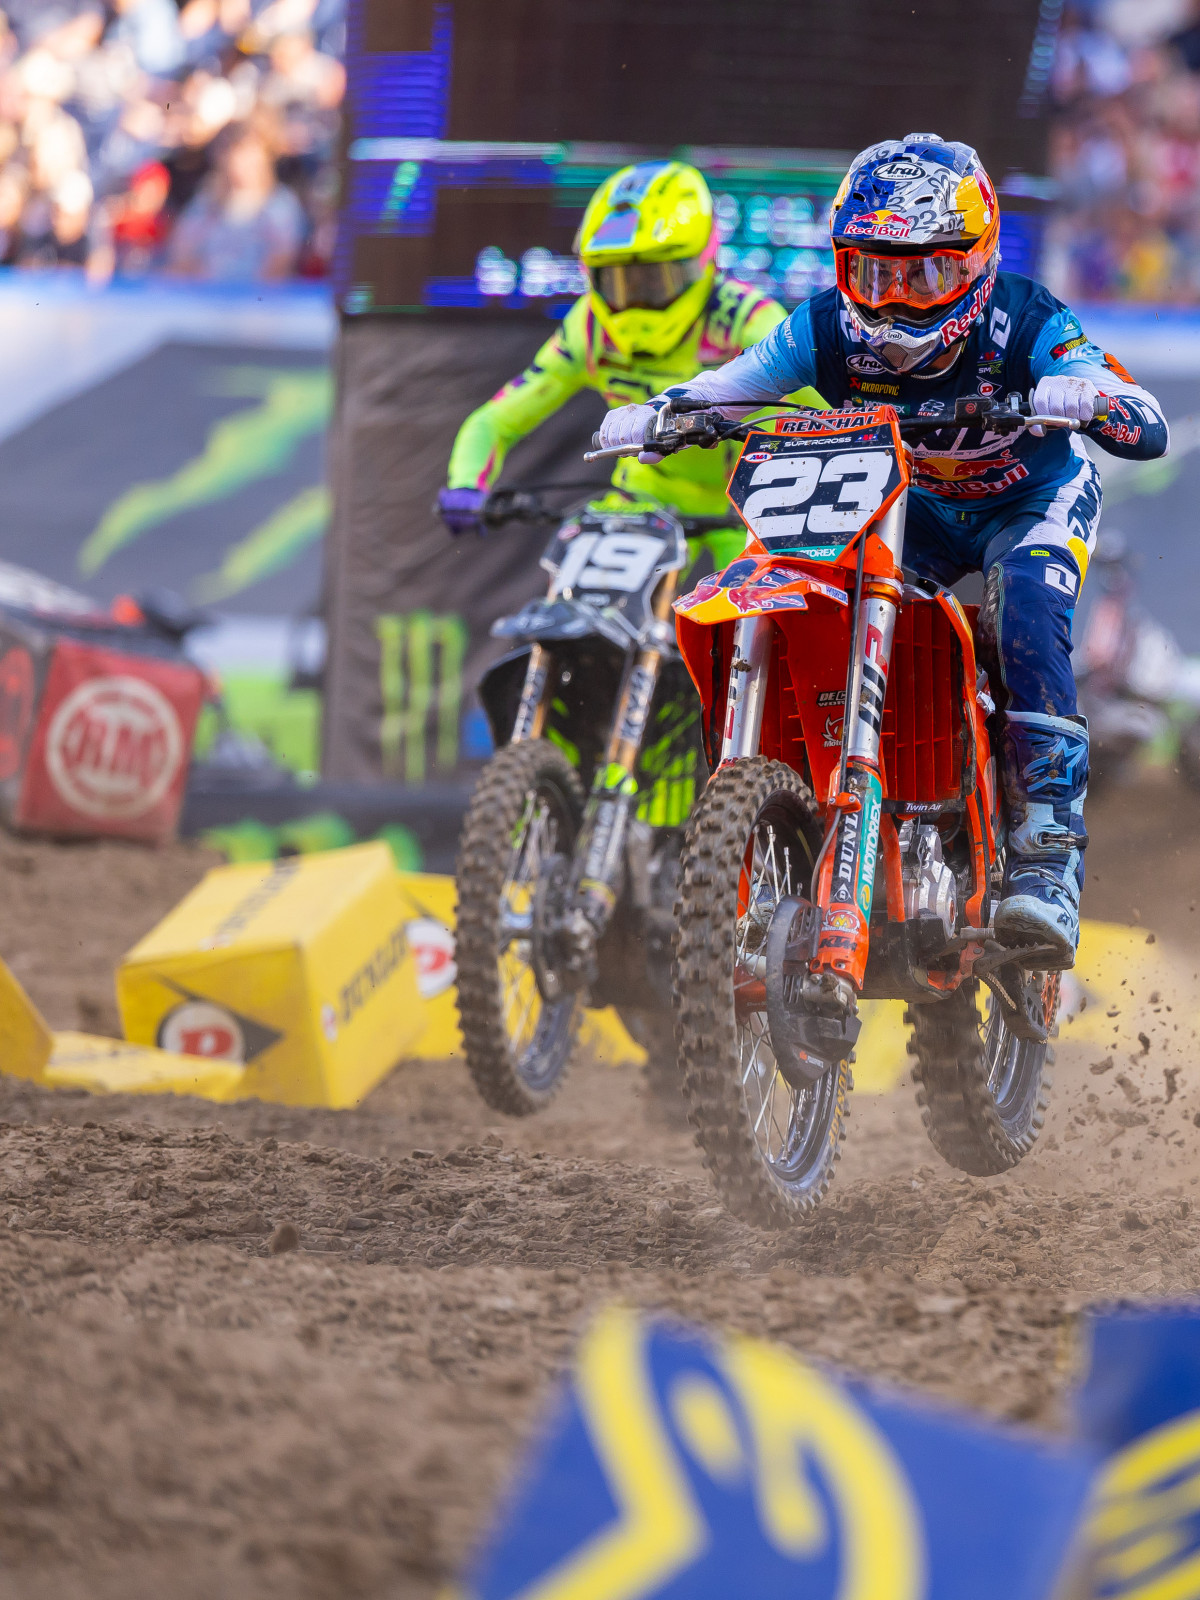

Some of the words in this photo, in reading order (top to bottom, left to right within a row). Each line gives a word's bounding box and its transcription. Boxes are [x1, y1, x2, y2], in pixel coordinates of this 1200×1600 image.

[876, 163, 920, 176] Arai
[844, 224, 877, 236] Red
[877, 225, 911, 238] Bull
[940, 291, 982, 347] Red
[781, 414, 880, 434] RENTHAL
[783, 436, 852, 448] SUPERCROSS
[1116, 423, 1142, 446] Bull
[916, 477, 956, 493] ed
[958, 463, 1030, 494] Bull
[742, 451, 894, 539] 23
[553, 531, 668, 594] 19
[799, 547, 836, 558] TOREX
[905, 803, 929, 812] Twin
[930, 803, 943, 812] Air
[861, 799, 882, 885] MOTOREX
[818, 935, 858, 953] KTM
